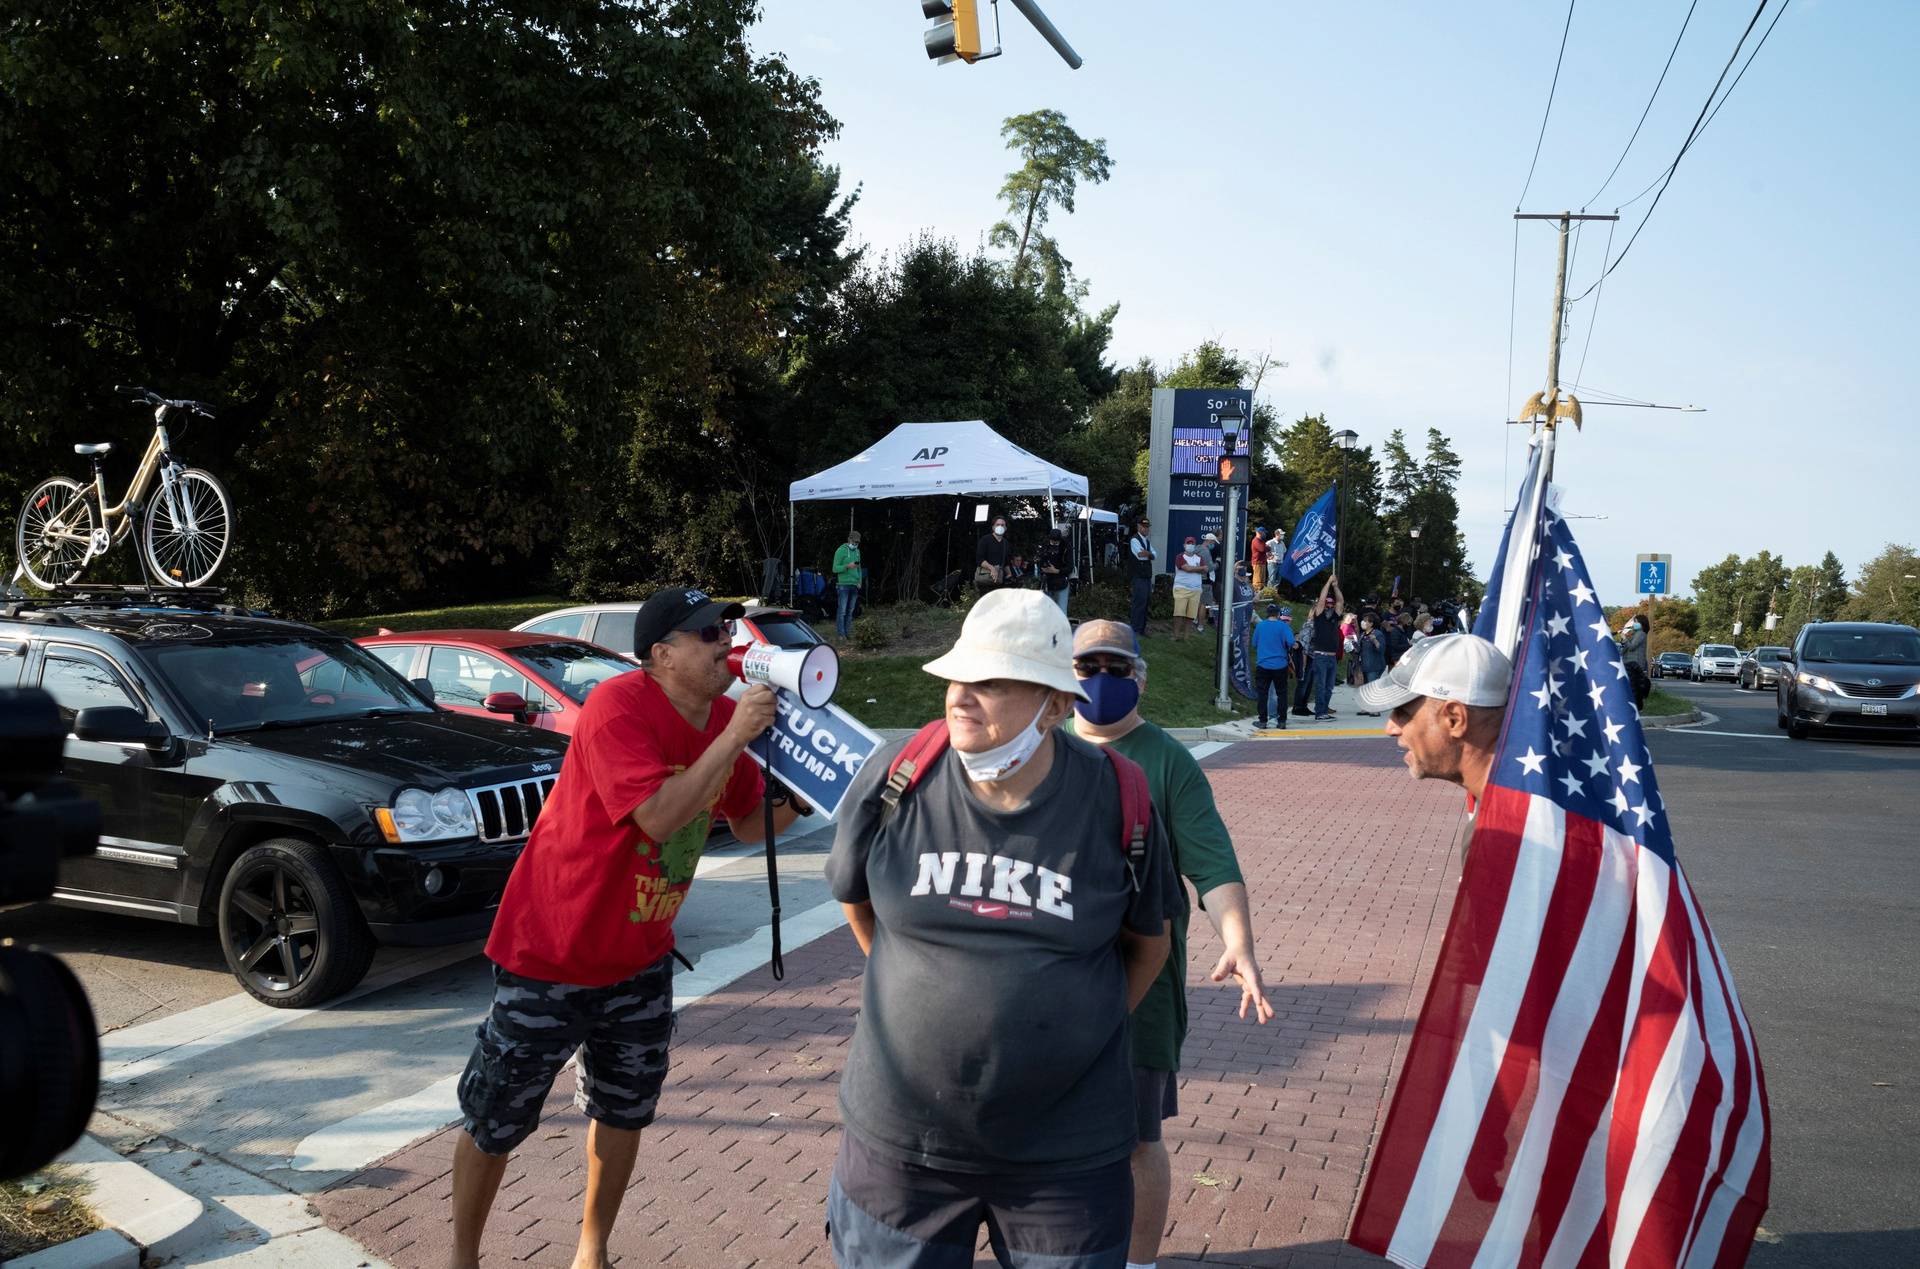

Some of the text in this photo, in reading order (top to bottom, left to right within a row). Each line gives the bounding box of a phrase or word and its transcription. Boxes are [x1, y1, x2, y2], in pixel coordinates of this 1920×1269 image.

[1207, 399, 1246, 409] Soh
[912, 447, 949, 461] AP
[1183, 479, 1225, 488] Employ
[1183, 490, 1211, 498] Metro
[776, 697, 864, 775] FUCK
[769, 727, 837, 782] TRUMP
[532, 763, 552, 772] Jeep
[635, 873, 669, 893] THE
[910, 852, 1074, 921] NIKE
[637, 891, 684, 922] VIR
